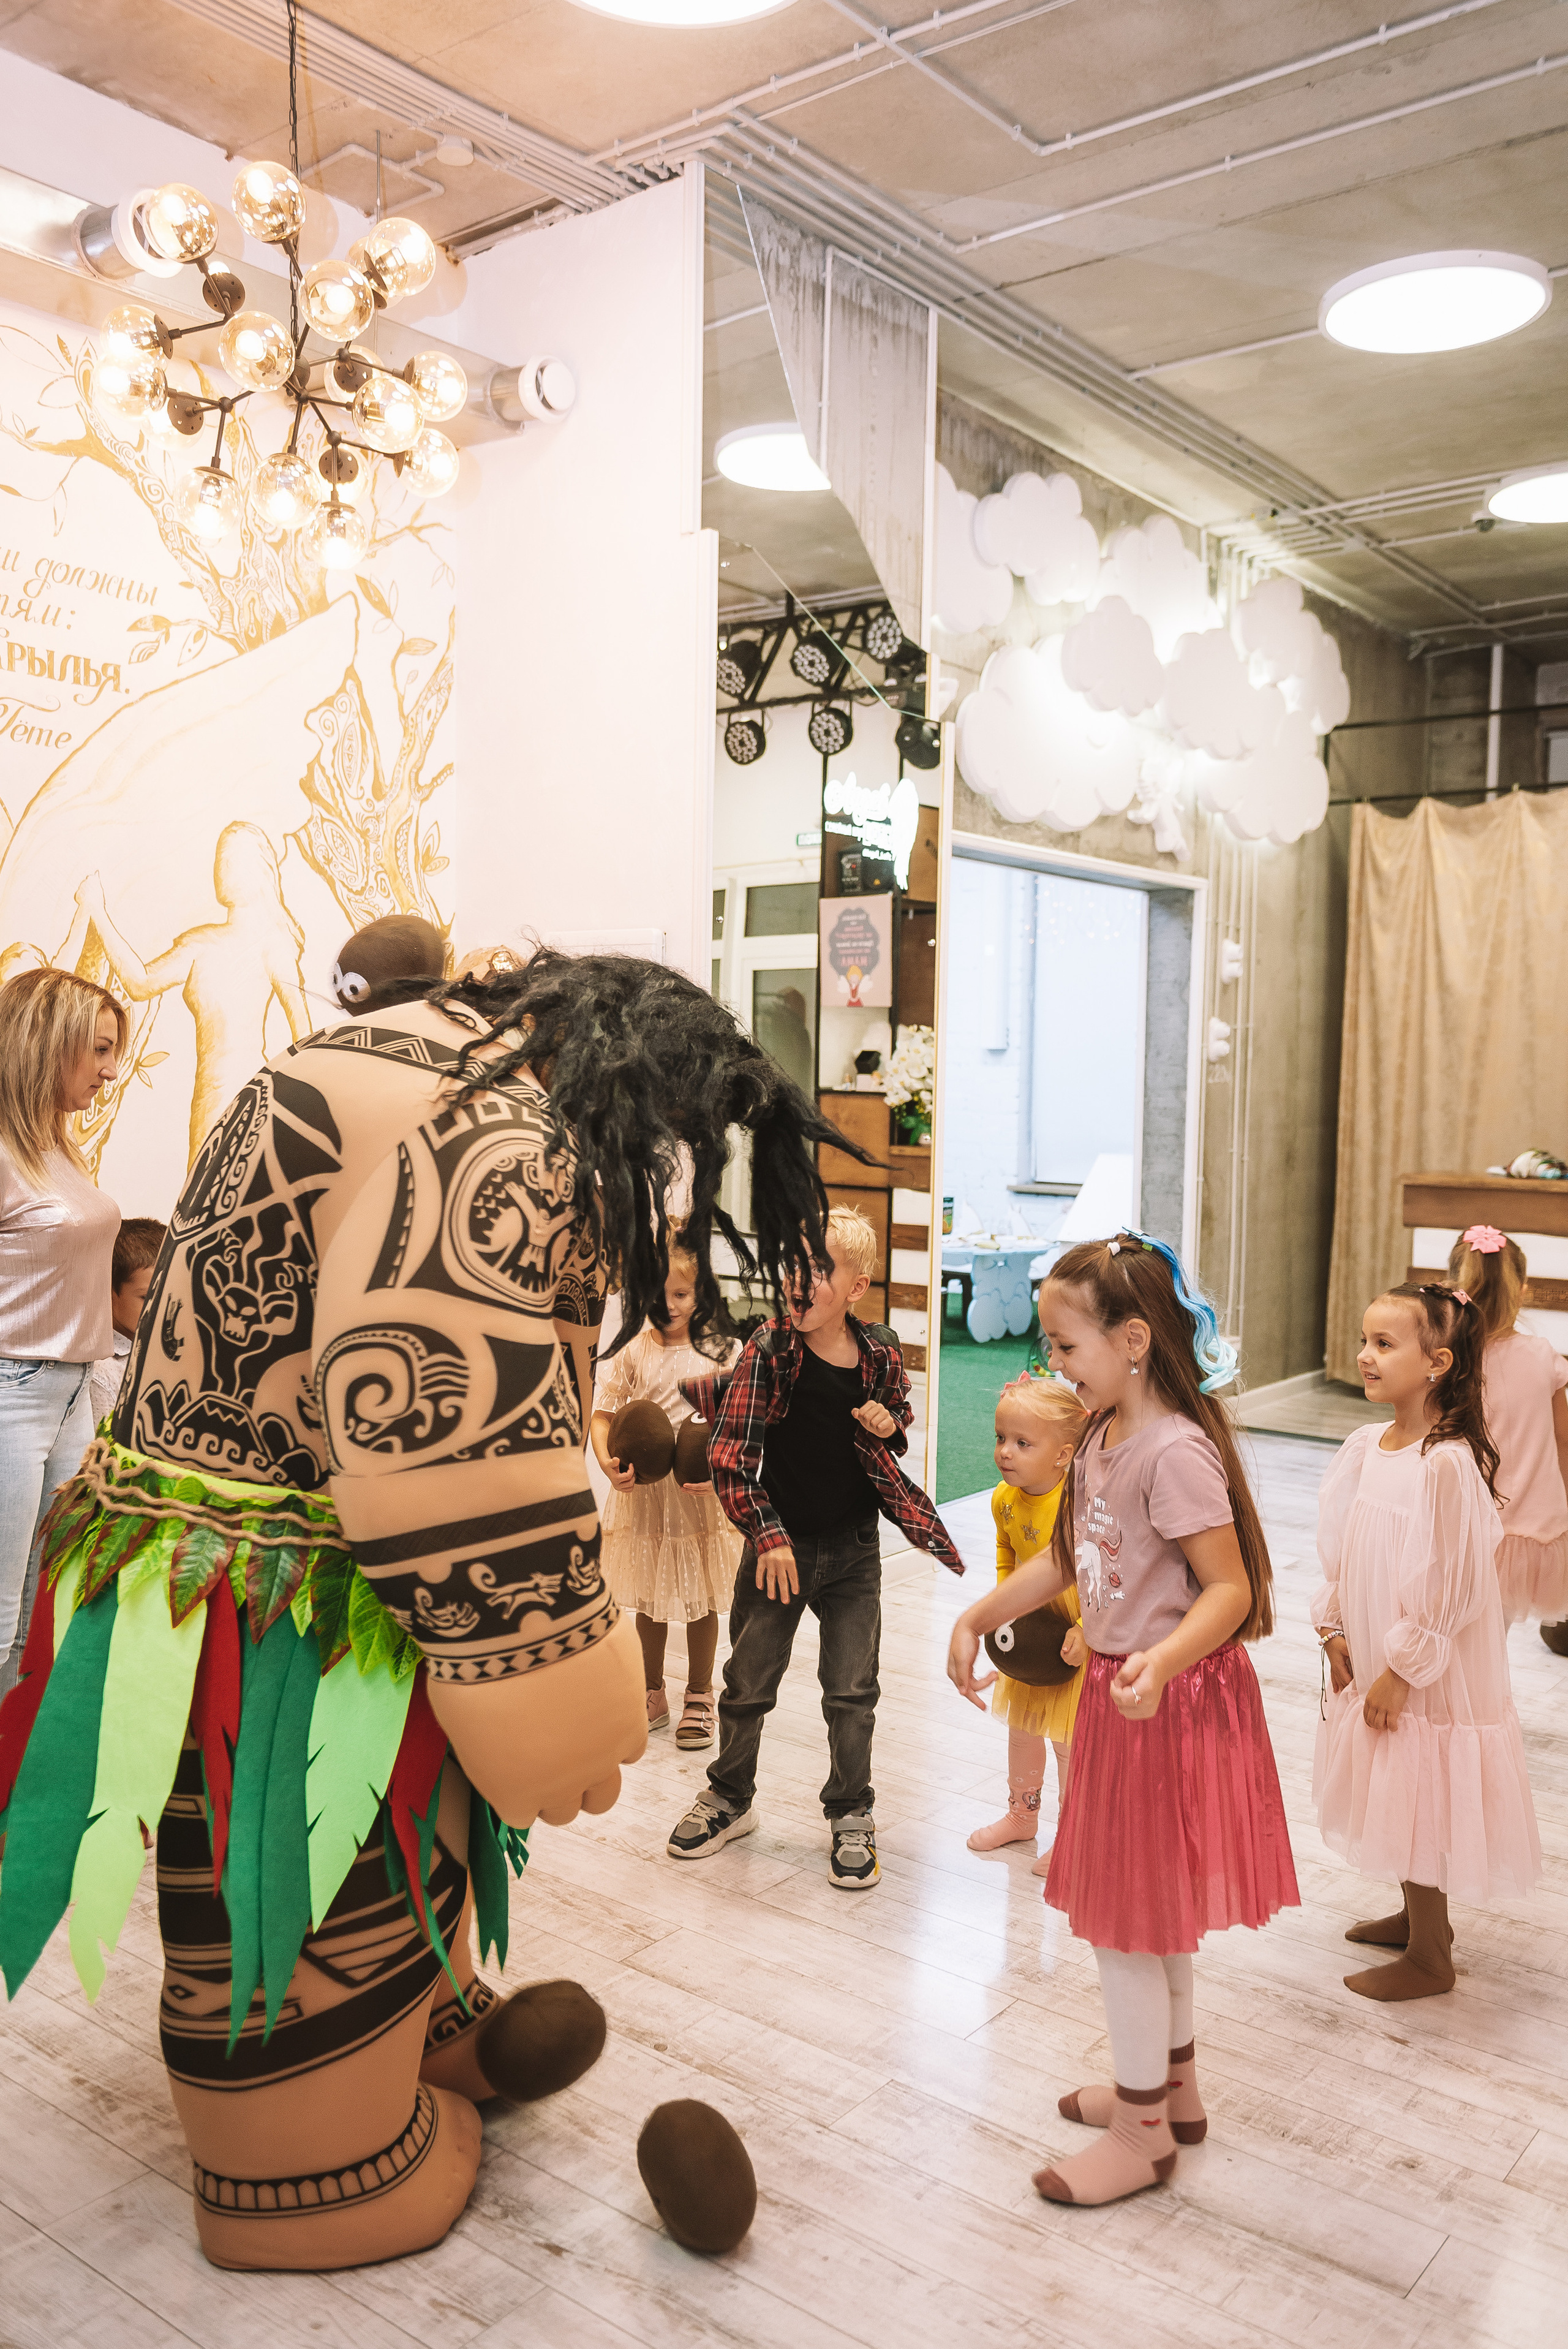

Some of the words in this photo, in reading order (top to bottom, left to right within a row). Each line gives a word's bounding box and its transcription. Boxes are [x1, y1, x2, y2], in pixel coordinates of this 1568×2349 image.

[23, 558, 158, 606] должны
[0, 631, 130, 706] РЫЛЬЯ.
[1088, 1522, 1106, 1535] space
[1094, 1511, 1114, 1526] magic
